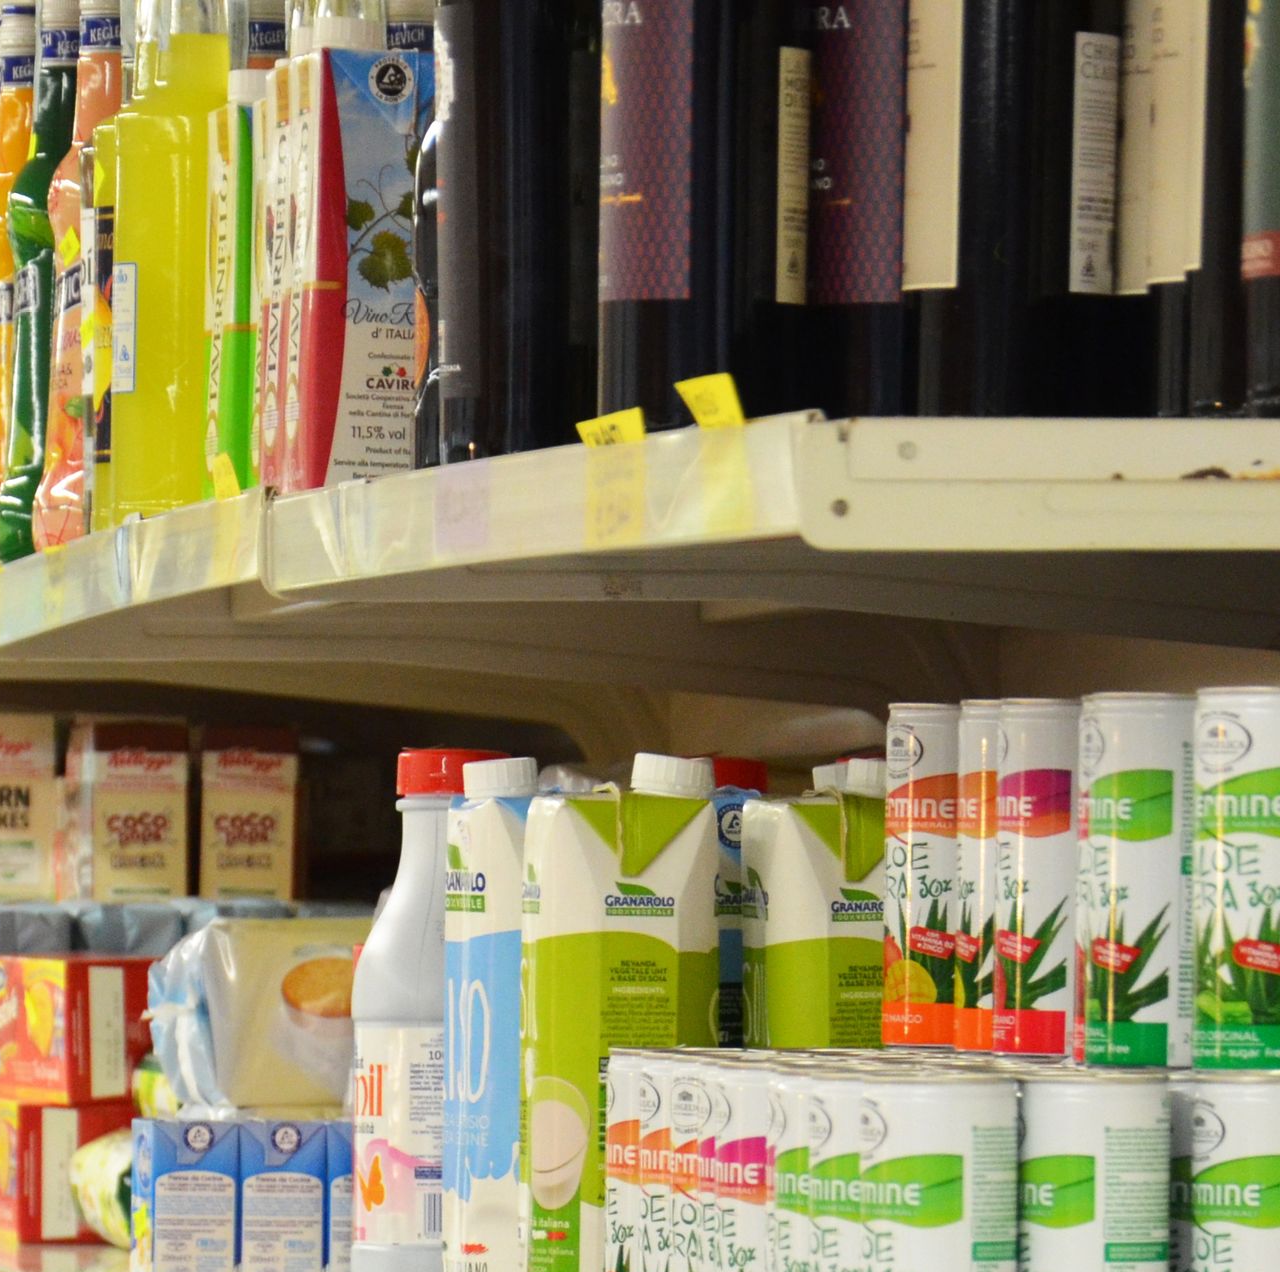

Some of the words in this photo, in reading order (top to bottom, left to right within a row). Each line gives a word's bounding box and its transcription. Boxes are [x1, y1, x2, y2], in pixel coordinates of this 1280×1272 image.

[341, 297, 389, 326] Vino
[387, 426, 406, 441] vol
[604, 893, 675, 908] GRANAROLO
